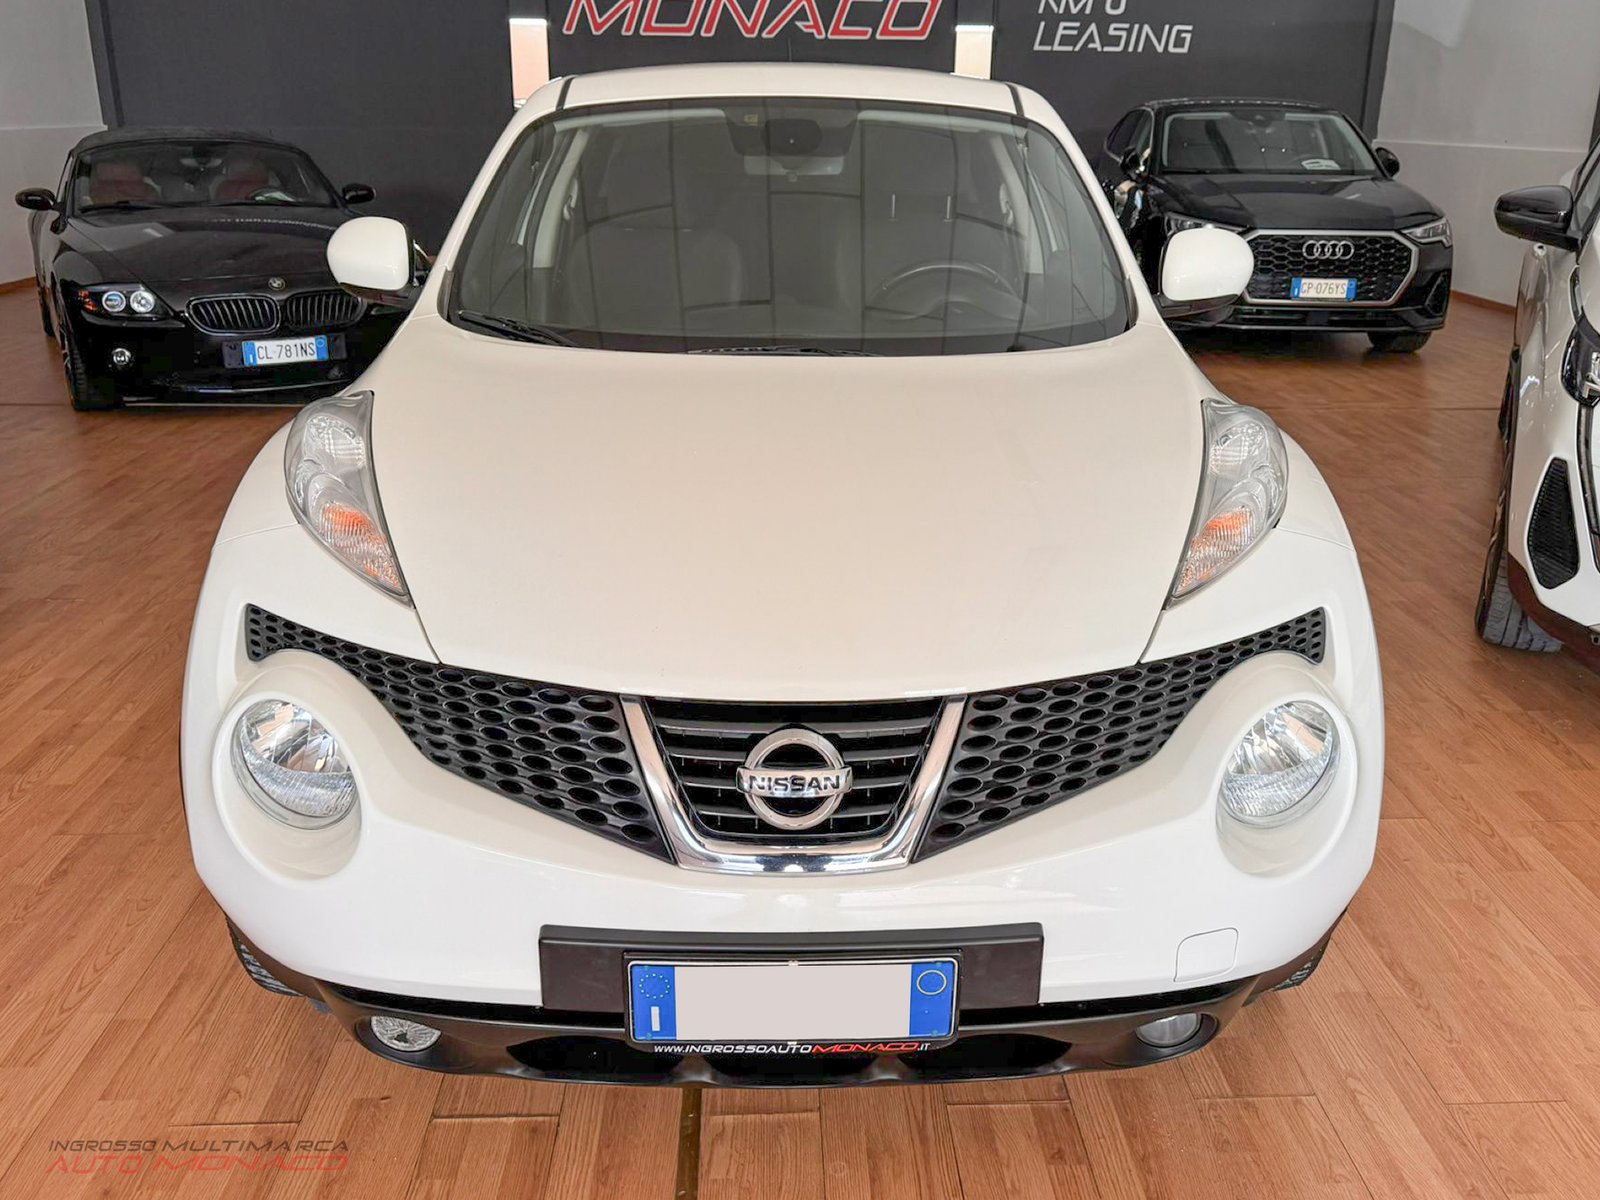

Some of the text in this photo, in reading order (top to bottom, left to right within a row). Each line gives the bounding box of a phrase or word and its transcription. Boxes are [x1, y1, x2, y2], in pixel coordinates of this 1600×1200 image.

[563, 0, 942, 40] MONACO
[1033, 20, 1194, 54] LEASING
[749, 774, 840, 792] NISSAN
